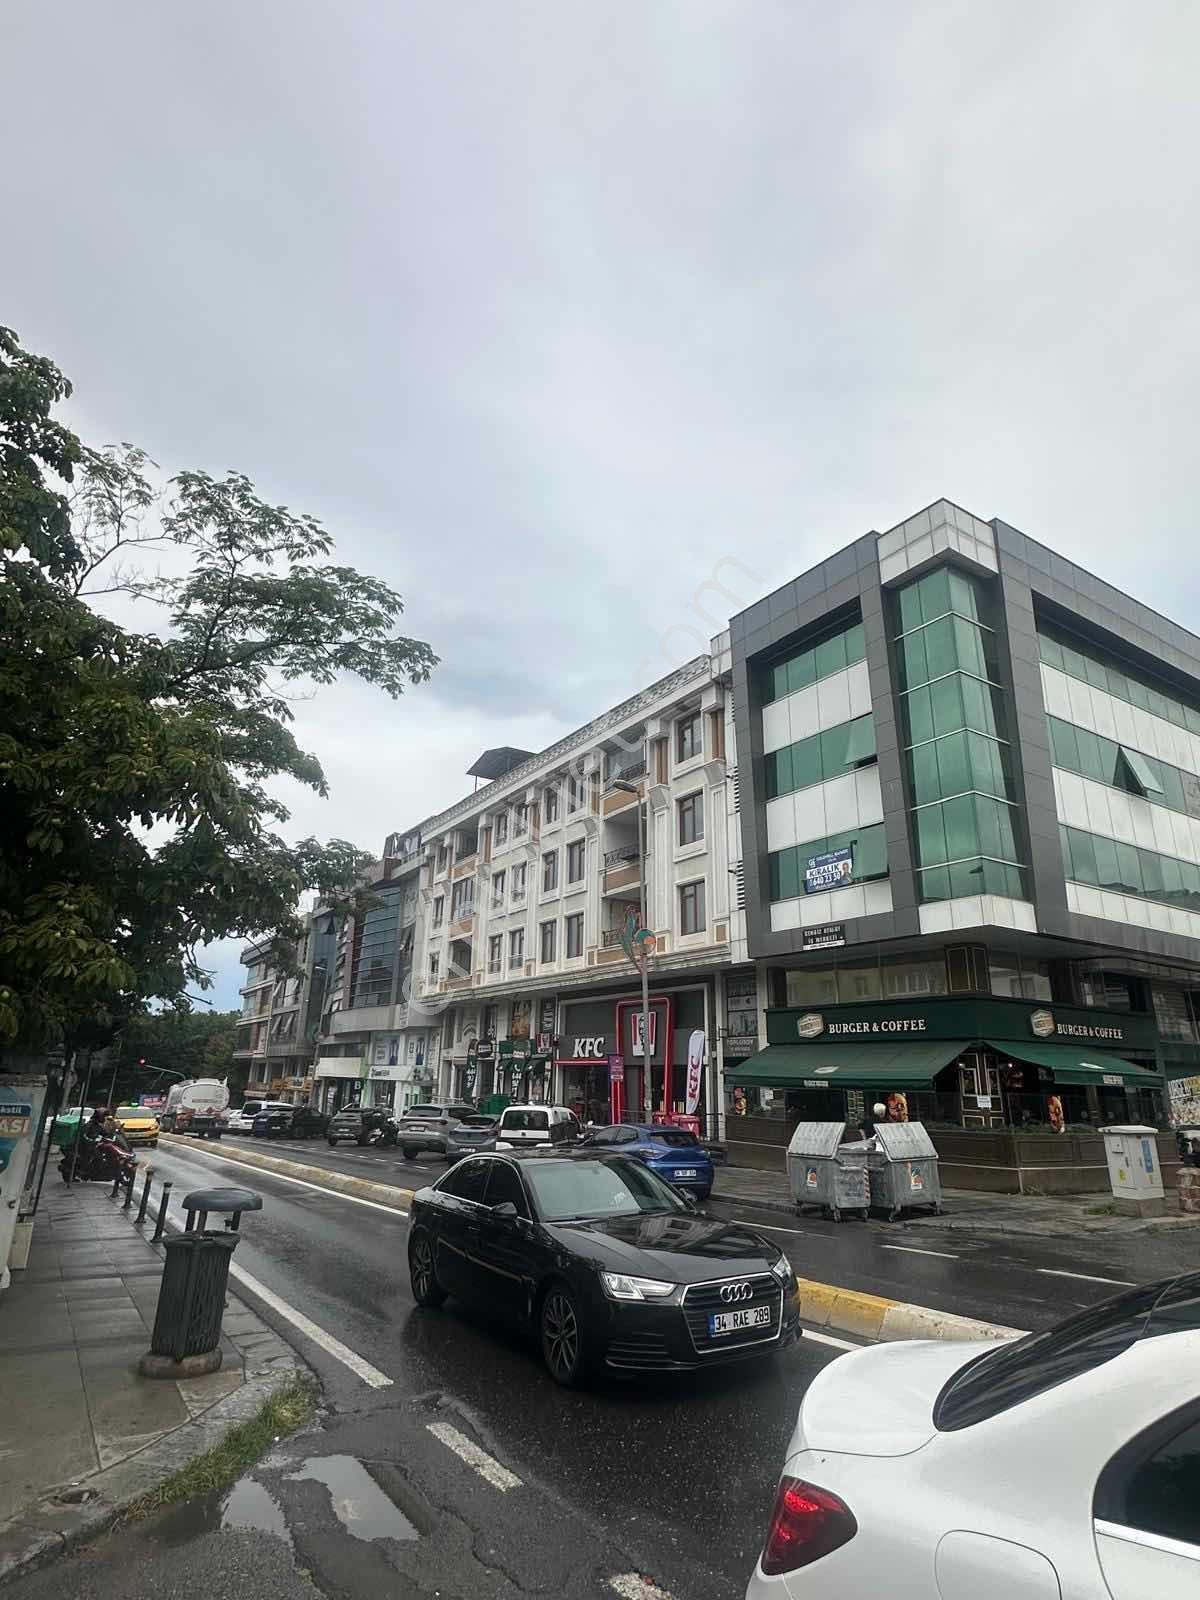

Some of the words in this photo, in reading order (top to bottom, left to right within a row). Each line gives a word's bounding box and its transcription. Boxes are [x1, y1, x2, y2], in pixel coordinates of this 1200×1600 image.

[828, 1022, 870, 1034] BURGER
[872, 1023, 879, 1032] &
[881, 1019, 926, 1032] COFFEE
[1057, 1023, 1089, 1036] BURGER
[1089, 1027, 1094, 1036] &
[1094, 1027, 1123, 1039] COFFEE
[573, 1037, 605, 1058] KFC
[688, 1055, 700, 1099] KFC
[715, 1315, 727, 1331] 34
[733, 1311, 749, 1328] RAE
[754, 1306, 769, 1324] 289
